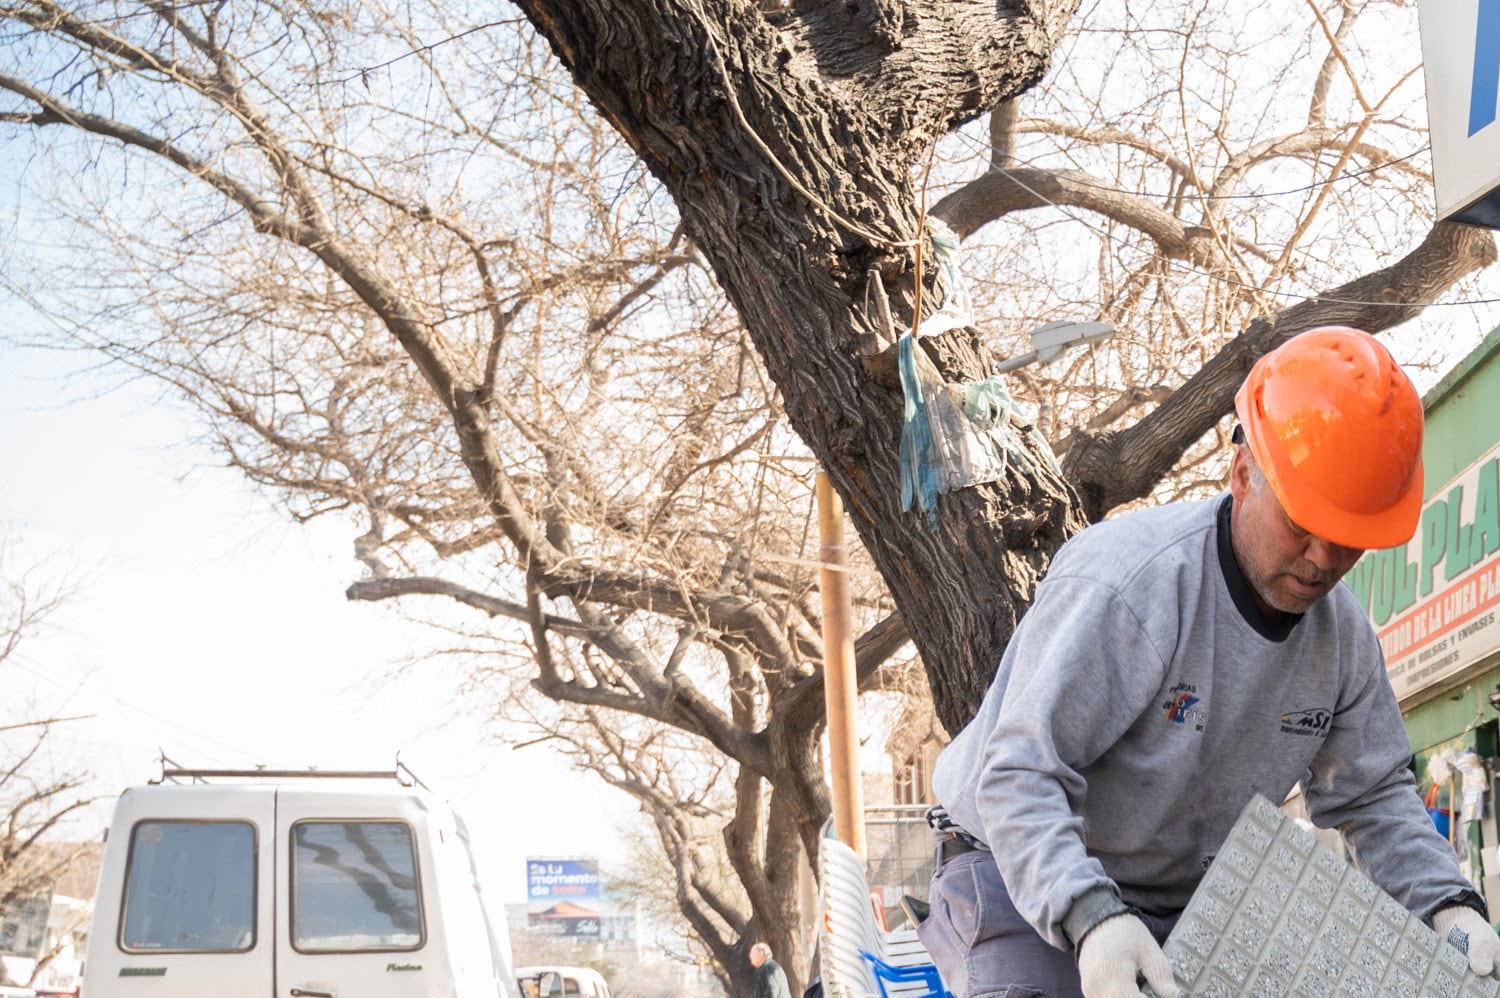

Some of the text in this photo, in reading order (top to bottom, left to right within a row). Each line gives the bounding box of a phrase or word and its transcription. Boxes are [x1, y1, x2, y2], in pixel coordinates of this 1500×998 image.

[1429, 602, 1442, 634] LA
[1444, 579, 1477, 625] LINEA
[1458, 611, 1495, 641] ENVASES
[1406, 649, 1460, 686] IMPRESIONES
[530, 873, 598, 885] momento
[530, 885, 550, 896] de
